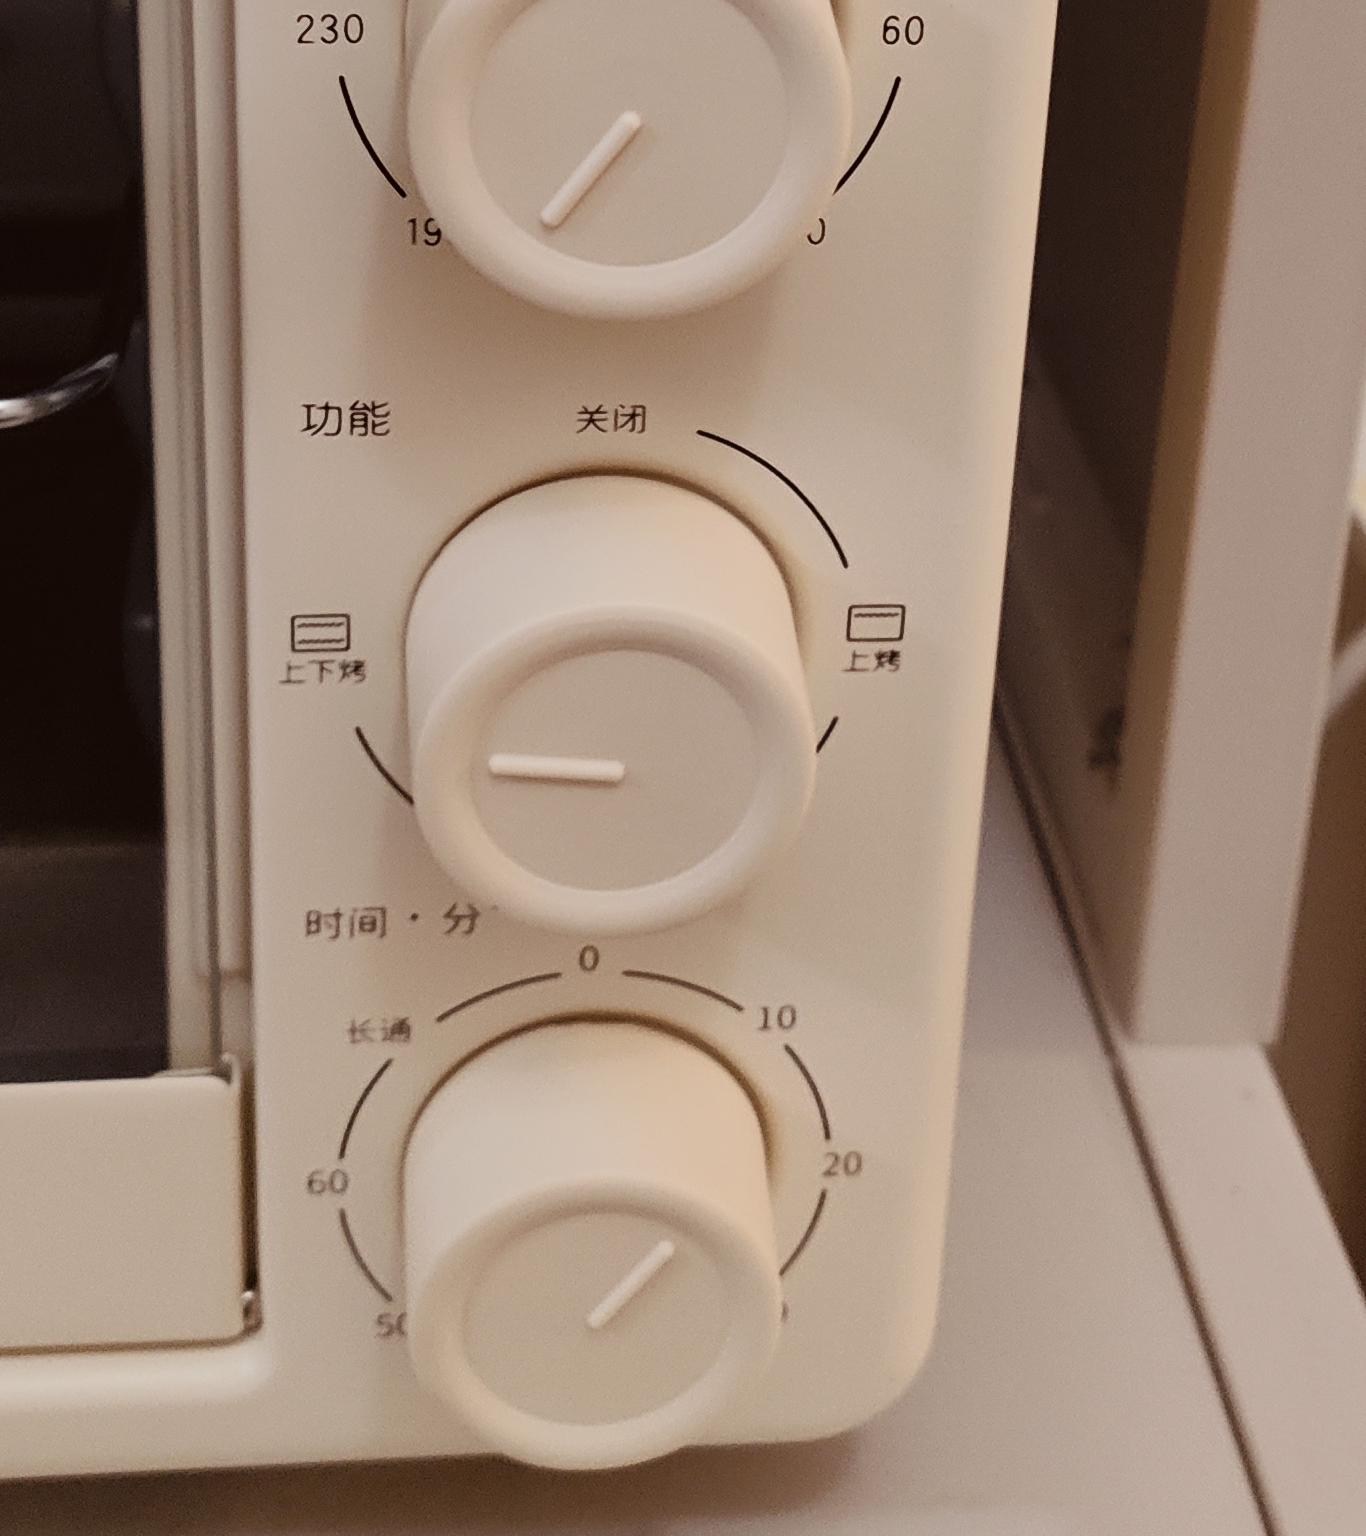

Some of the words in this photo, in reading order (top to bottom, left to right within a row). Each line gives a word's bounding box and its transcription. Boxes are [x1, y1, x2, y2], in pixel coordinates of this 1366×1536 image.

[296, 13, 365, 45] 230
[882, 15, 925, 46] 60
[302, 400, 391, 437] 功能
[578, 404, 647, 433] 关闭
[278, 659, 366, 684] 上下烤
[841, 649, 900, 672] 上烤
[578, 945, 600, 972] 0
[760, 1005, 797, 1031] 10
[822, 1152, 863, 1178] 20
[306, 1169, 349, 1195] 60
